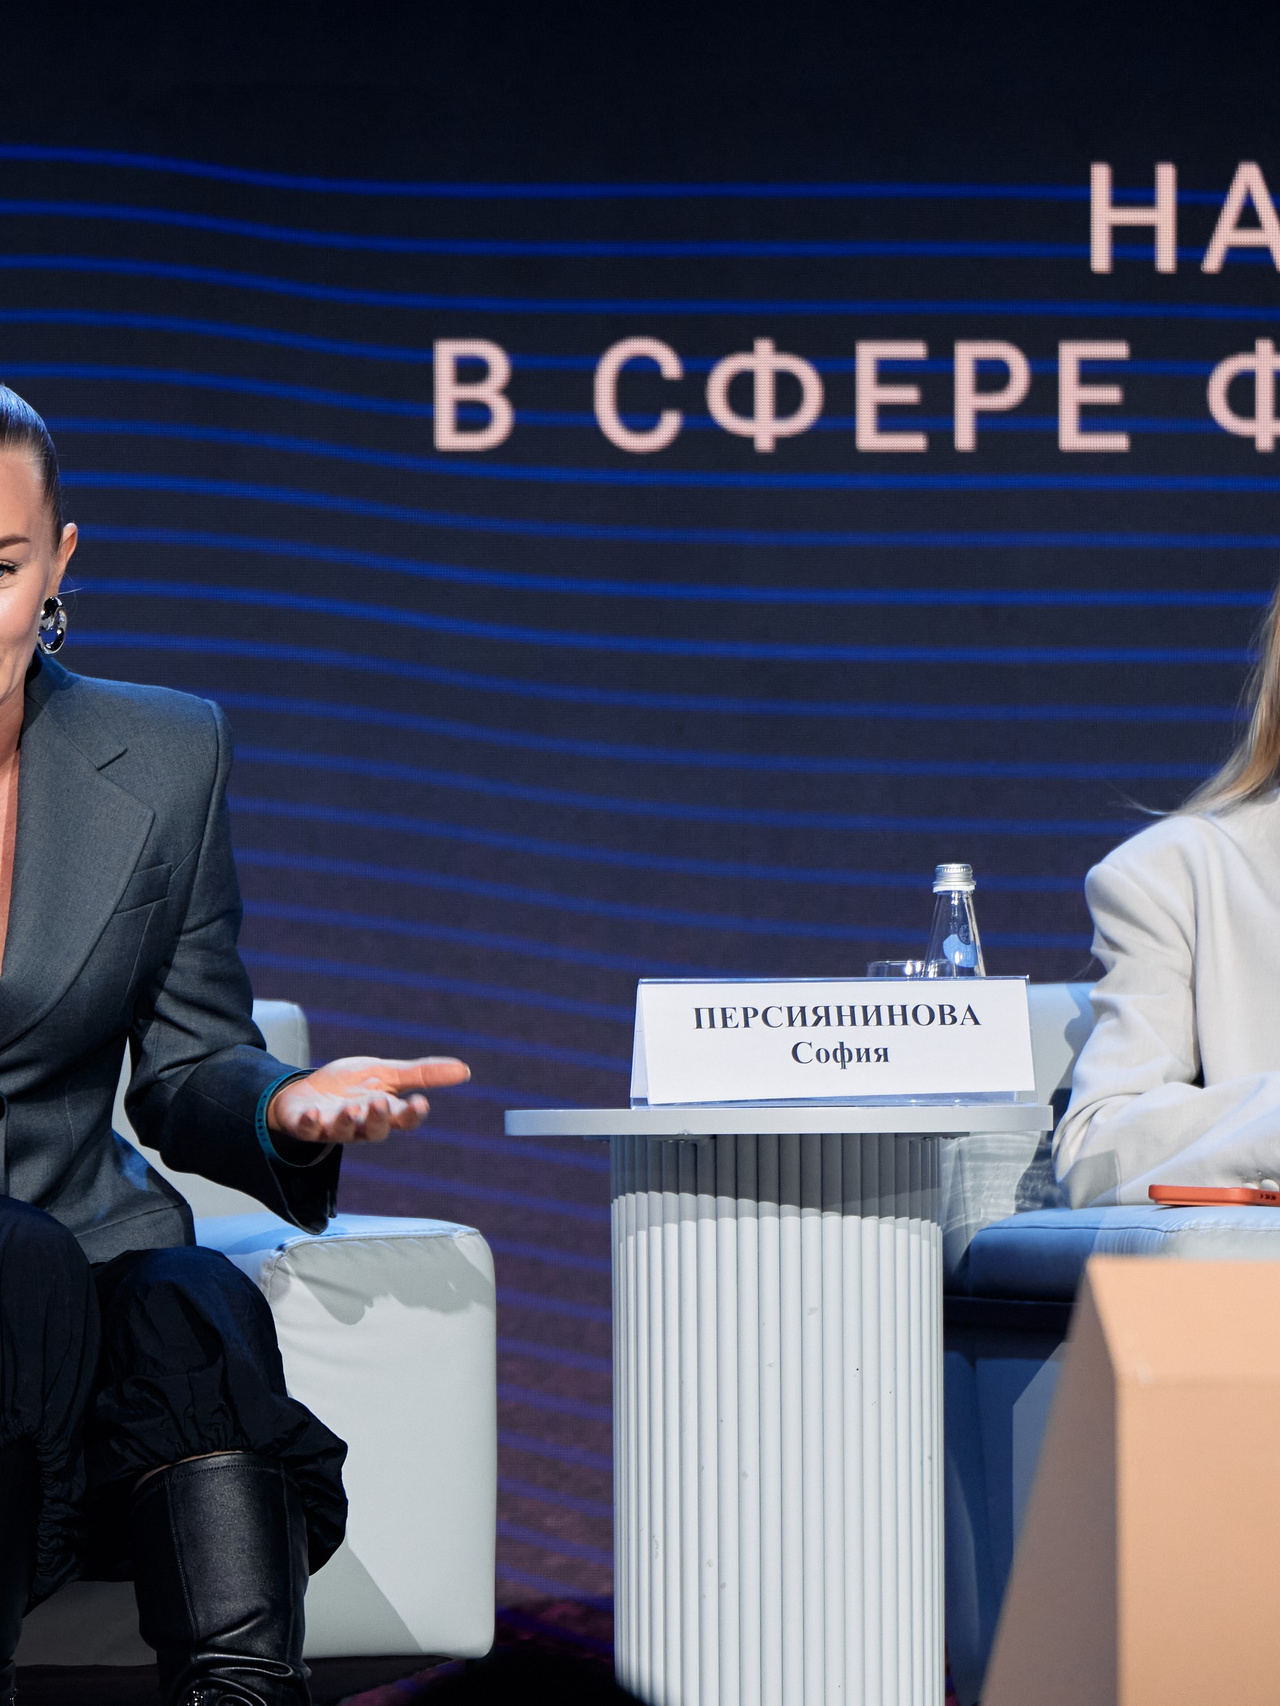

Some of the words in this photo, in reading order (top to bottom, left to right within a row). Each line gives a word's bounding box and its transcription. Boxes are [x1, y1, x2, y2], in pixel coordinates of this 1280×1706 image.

[1089, 161, 1280, 275] НА
[433, 338, 515, 453] В
[592, 336, 1131, 454] СФЕРЕ
[1206, 338, 1280, 453] Ф
[693, 1003, 982, 1030] ПЕРСИЯНИНОВА
[791, 1040, 890, 1070] София
